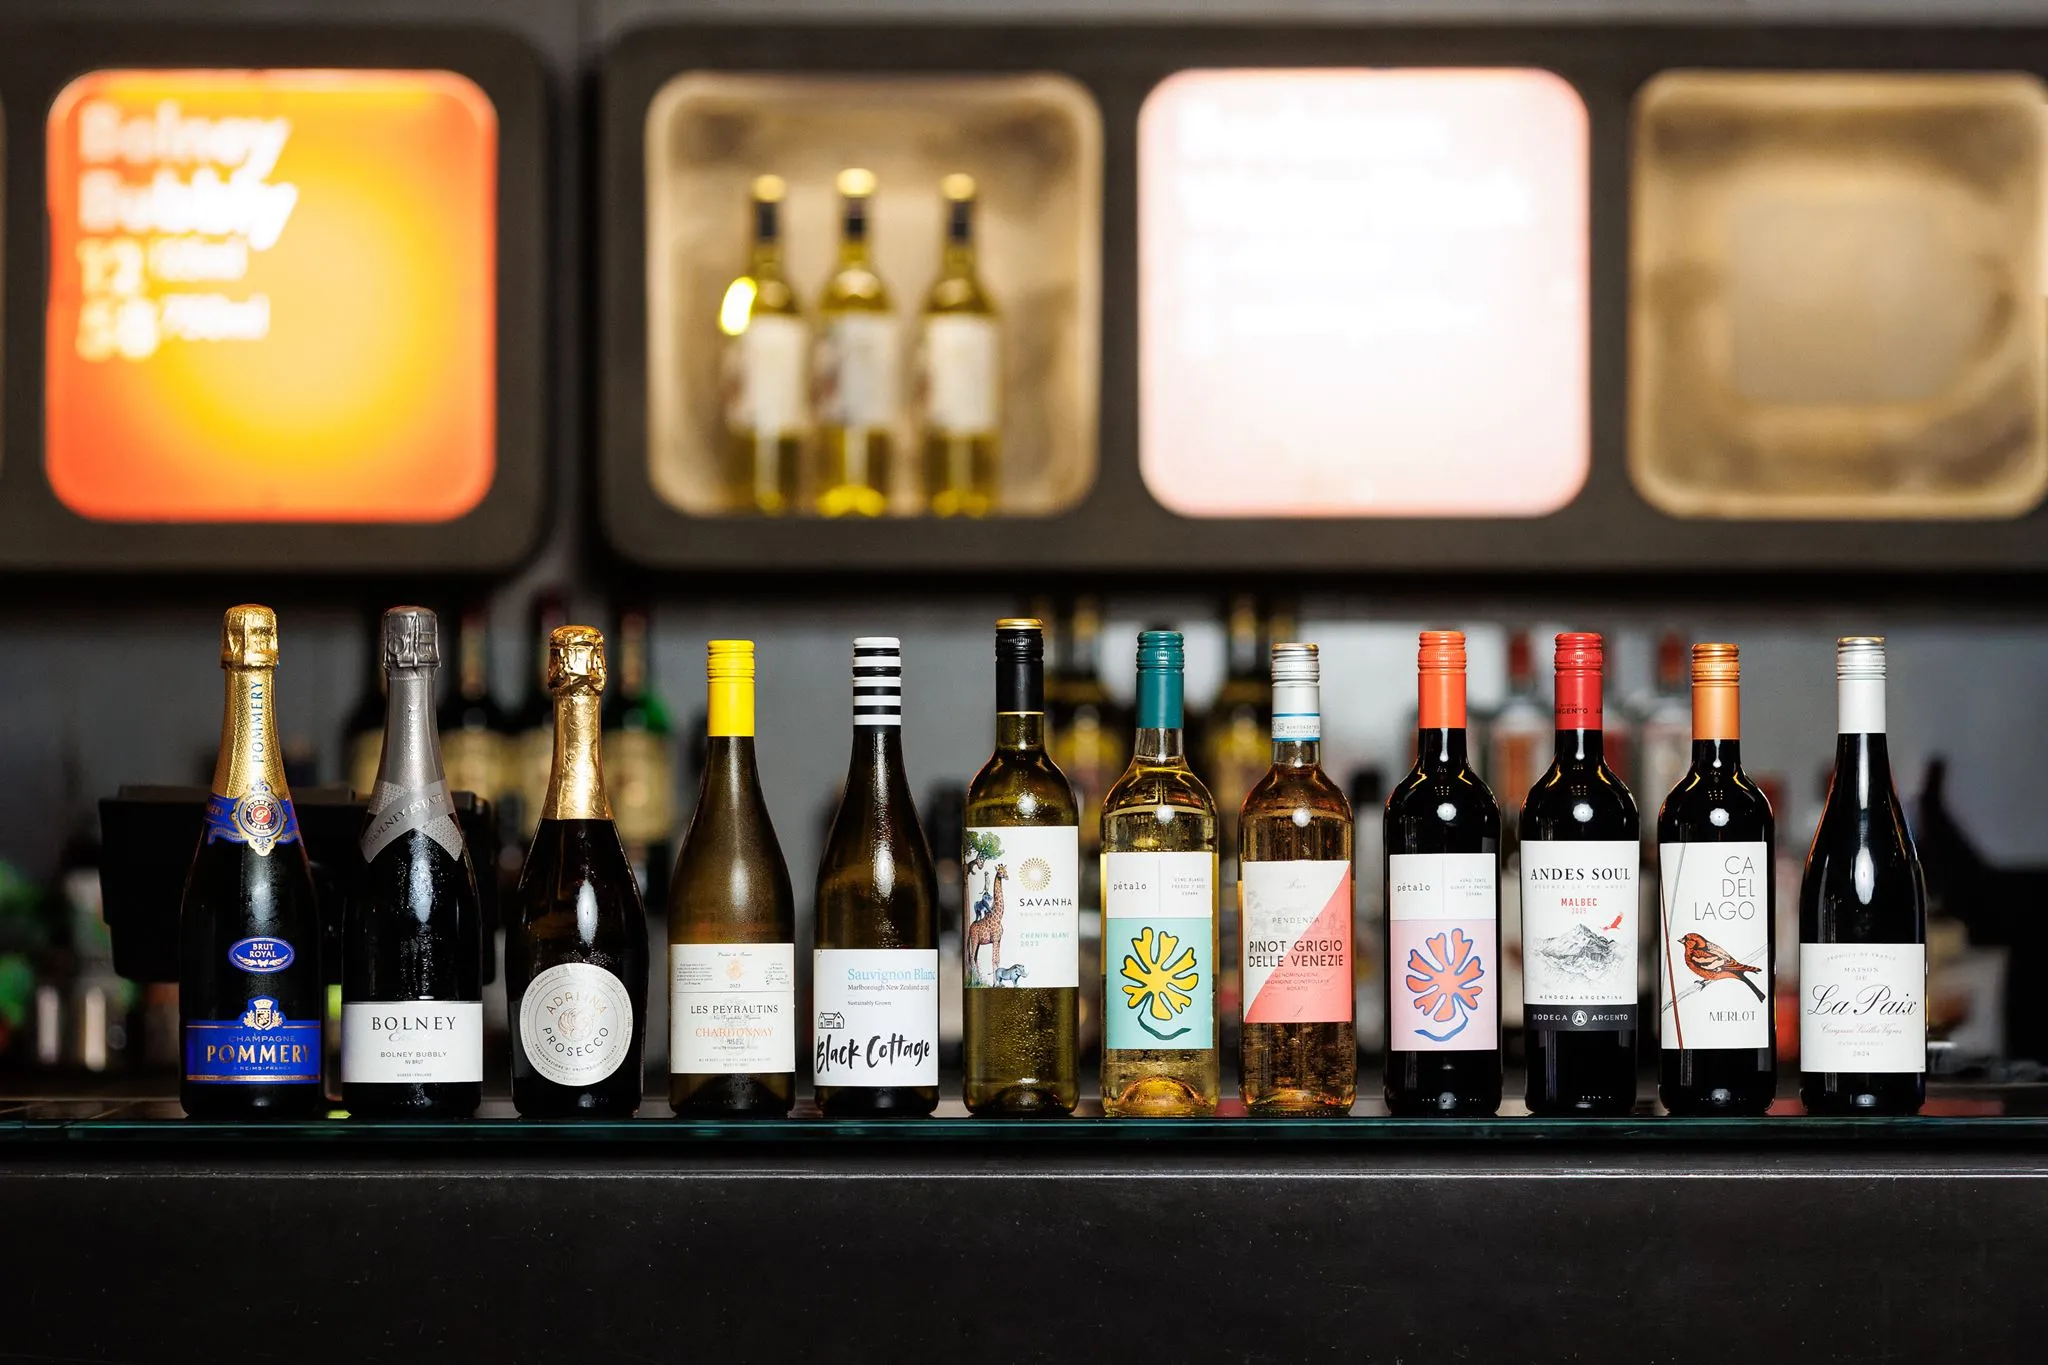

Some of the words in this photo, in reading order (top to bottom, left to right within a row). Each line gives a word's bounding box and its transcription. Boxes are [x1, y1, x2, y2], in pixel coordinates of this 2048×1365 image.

[250, 680, 265, 764] POMMERY
[1724, 855, 1756, 875] CA
[1530, 867, 1585, 881] ANDES
[1591, 867, 1631, 881] SOUL
[1113, 881, 1147, 891] pétalo
[1397, 882, 1431, 893] pétalo
[1722, 878, 1756, 898] DEL
[1019, 897, 1073, 907] SAVANHA
[1560, 897, 1598, 907] MALBEC
[1694, 901, 1756, 921] LAGO
[252, 943, 274, 951] BRUT
[1249, 940, 1287, 953] PINOT
[1293, 939, 1343, 952] GRIGIO
[249, 950, 277, 958] ROYAL
[1249, 955, 1284, 968] DELLE
[1291, 954, 1344, 967] VENEZIE
[847, 968, 912, 984] Sauvignon
[914, 967, 936, 981] Blanc
[847, 984, 885, 992] Marlborough
[1806, 984, 1853, 1016] La
[1853, 983, 1918, 1016] Paix
[690, 1005, 708, 1014] LES
[712, 1004, 779, 1014] PEYRAUTINS
[1709, 1010, 1756, 1022] MERLOT
[371, 1016, 456, 1031] BOLNEY
[228, 1035, 296, 1043] CHAMPAGNE
[695, 1027, 774, 1037] CHARDONNAY
[542, 1026, 609, 1057] PROSECCO
[206, 1044, 310, 1064] POMMERY
[816, 1034, 862, 1074] Black
[866, 1032, 930, 1068] Cottage
